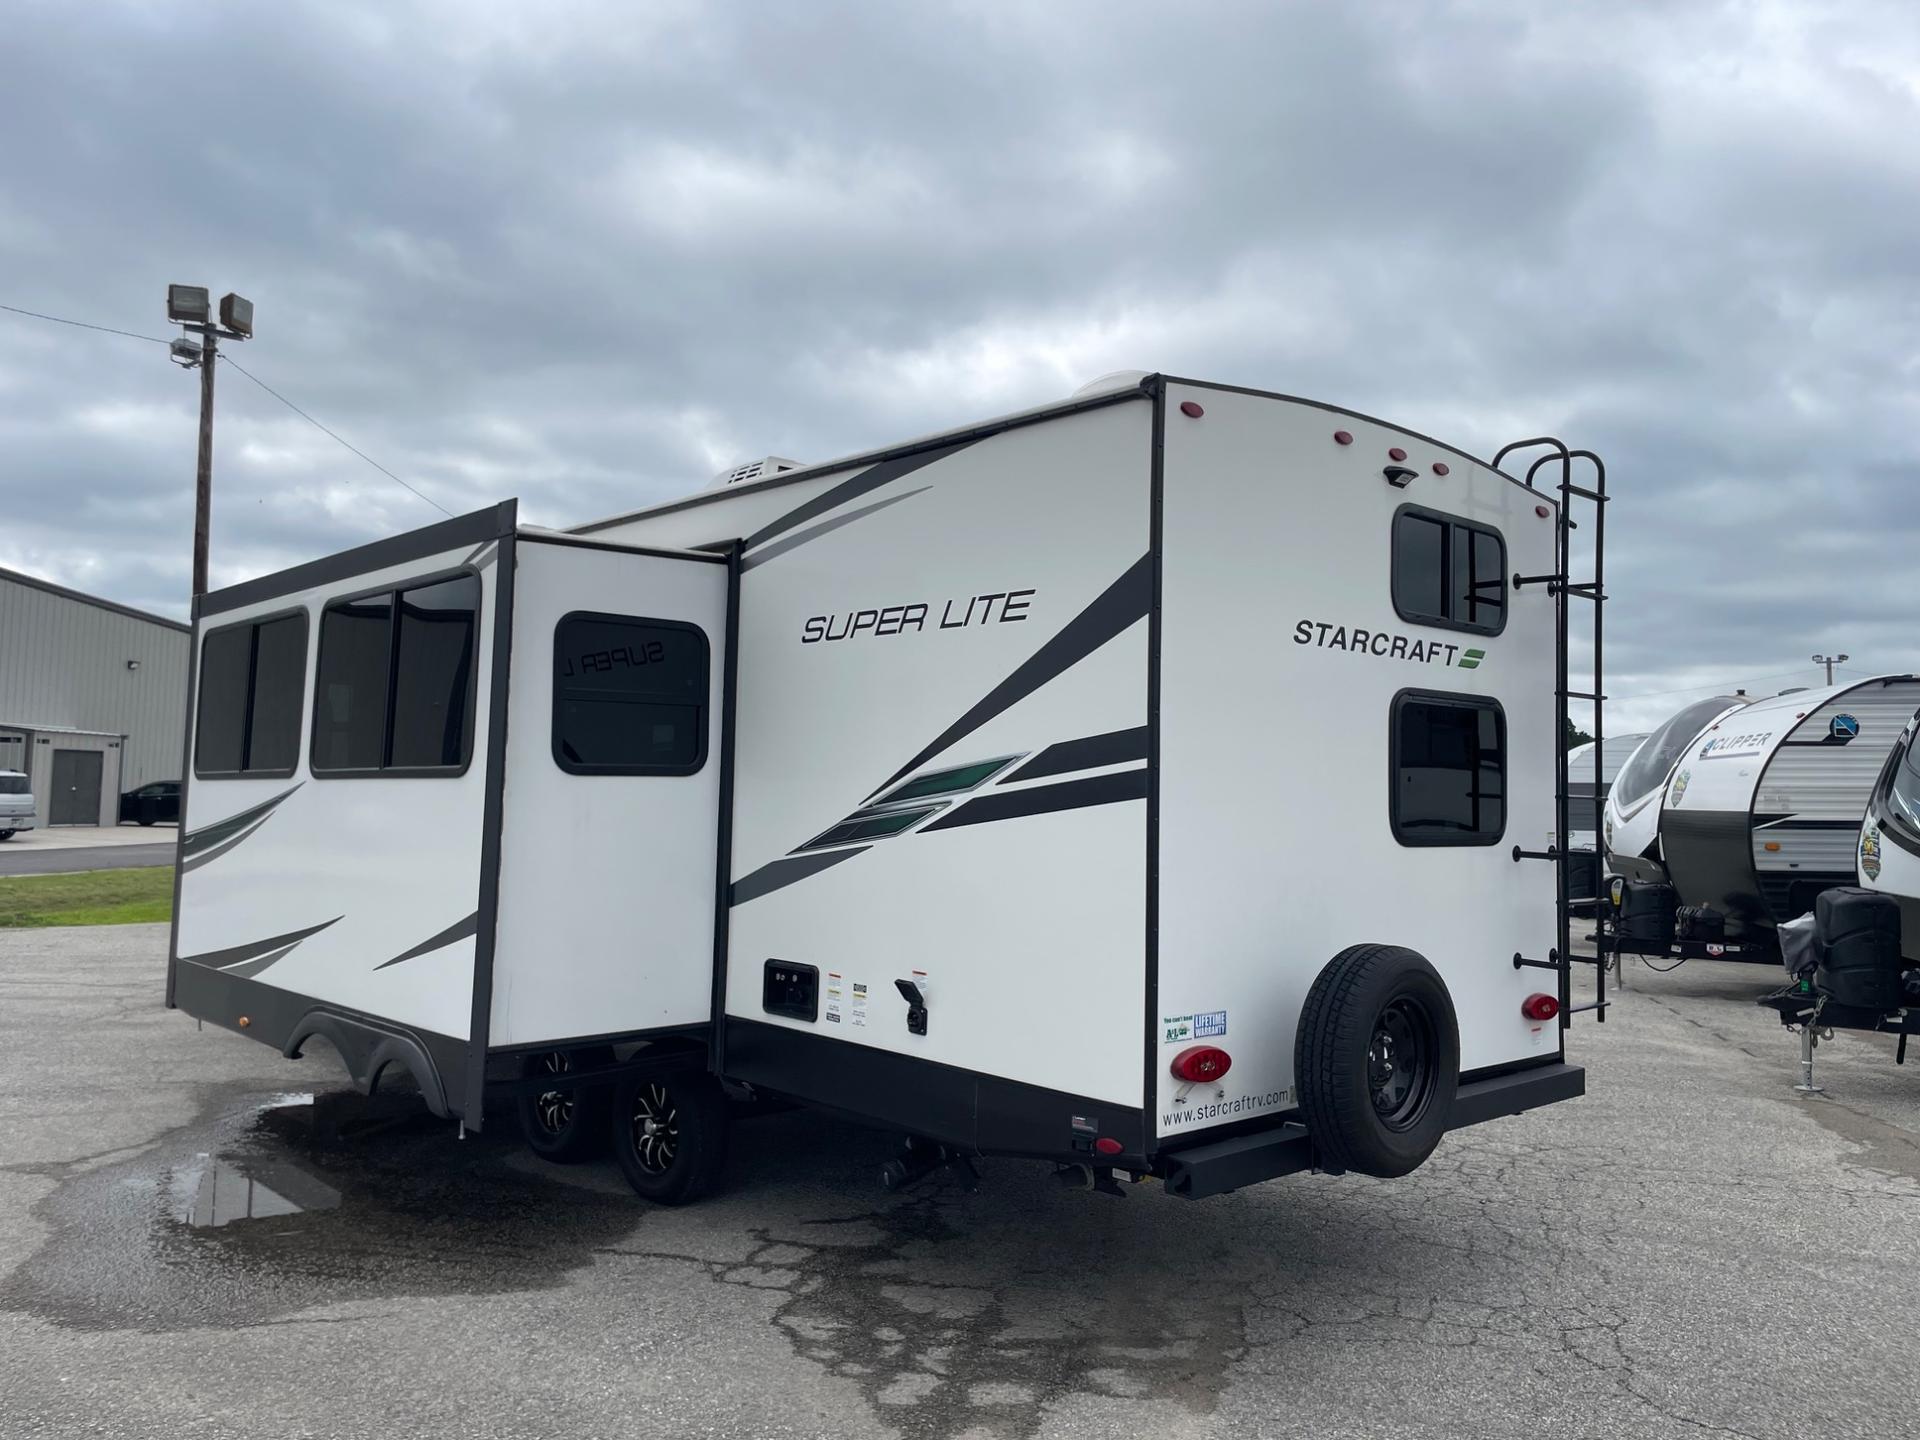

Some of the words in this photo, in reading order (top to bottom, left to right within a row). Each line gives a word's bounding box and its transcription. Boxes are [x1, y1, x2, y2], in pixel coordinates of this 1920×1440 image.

[802, 603, 928, 643] SUPER
[939, 589, 1036, 629] LITE
[1293, 619, 1459, 667] STARCRAFT
[1712, 732, 1772, 751] CLIPPER
[1195, 1012, 1226, 1028] LIFETIME
[1195, 1025, 1226, 1037] WARRANTY
[1163, 1089, 1289, 1127] www.starcraftrv.com
